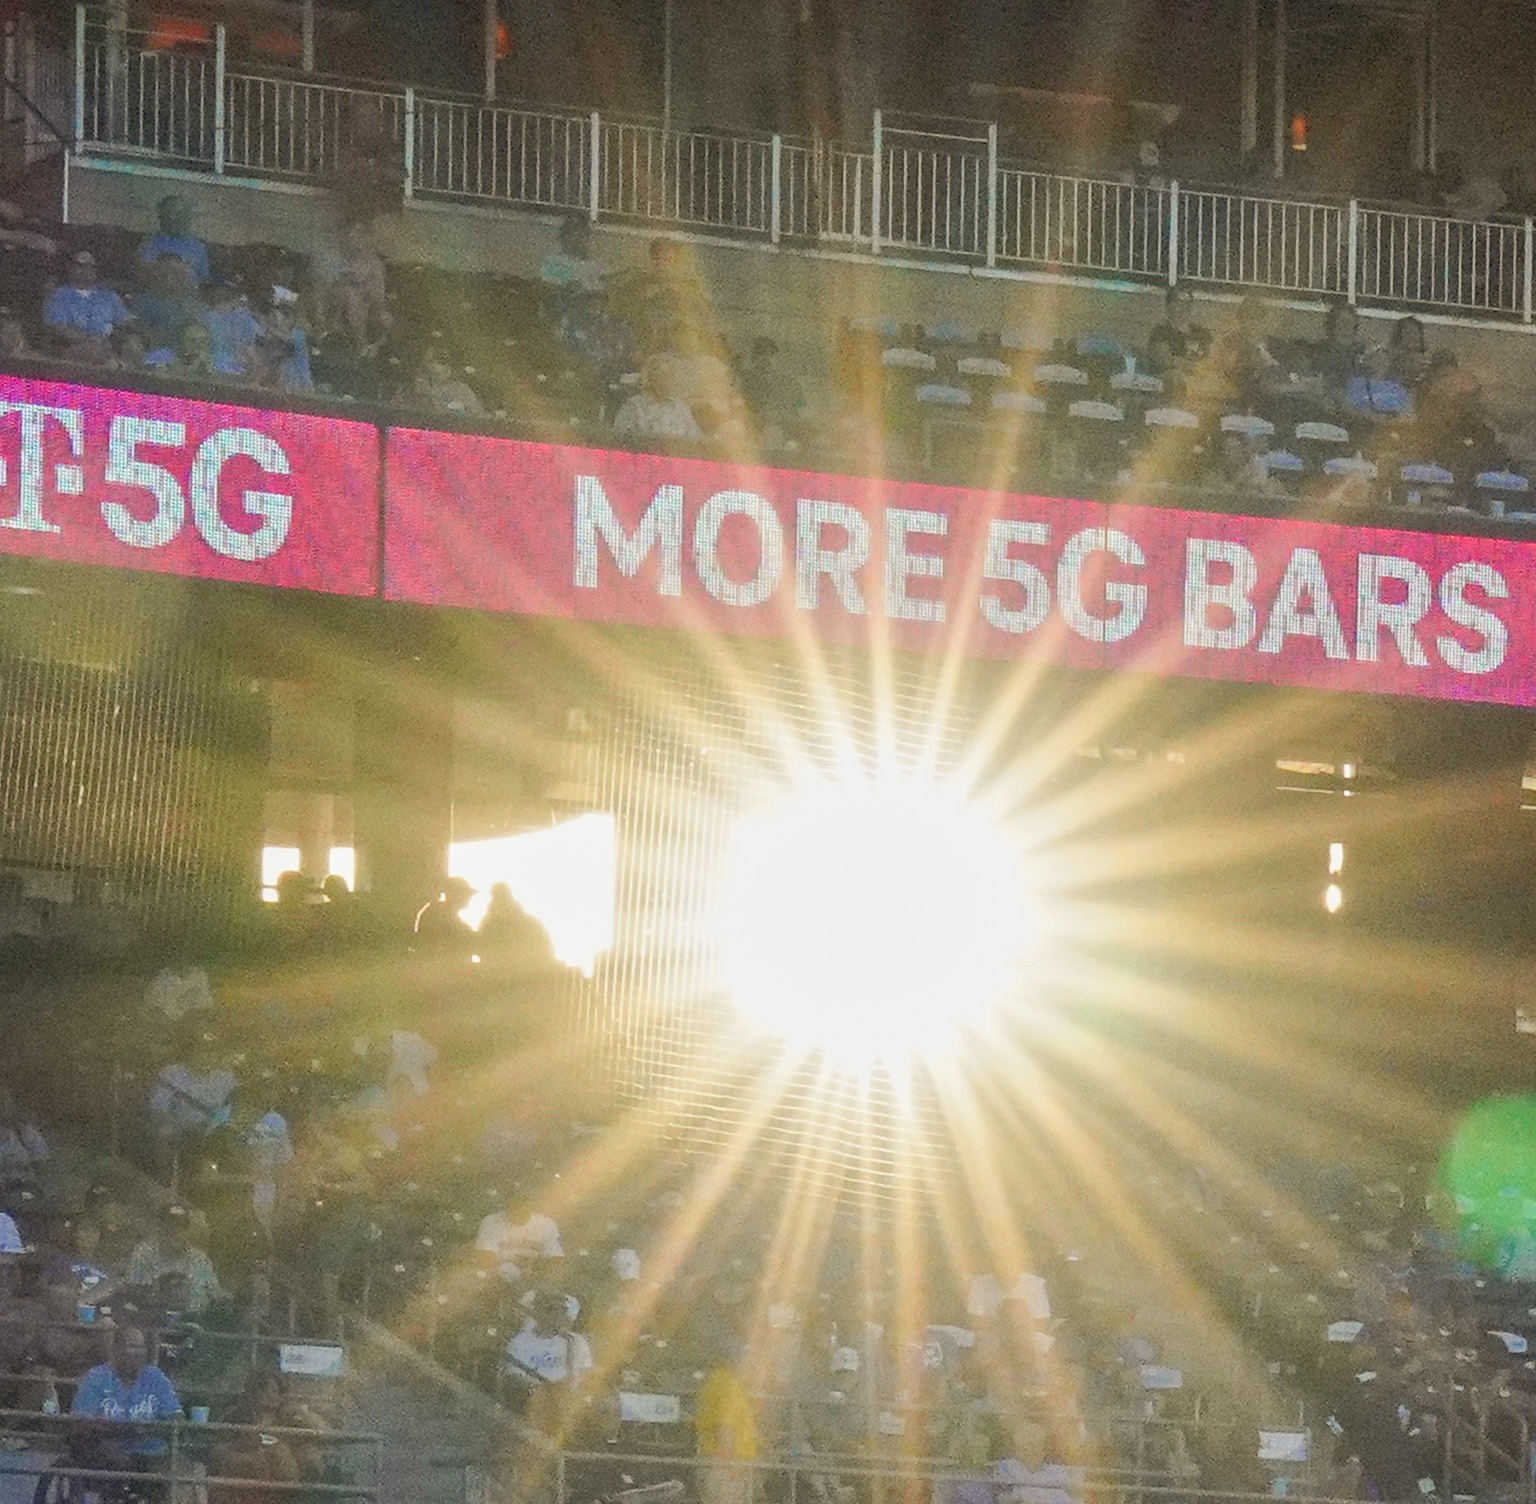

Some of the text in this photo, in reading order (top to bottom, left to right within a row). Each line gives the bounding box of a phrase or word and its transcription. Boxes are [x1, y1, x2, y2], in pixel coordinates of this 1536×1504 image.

[101, 414, 292, 562] 5G
[574, 474, 948, 623] MORE
[980, 518, 1147, 642] 5G
[1183, 537, 1507, 675] BARS
